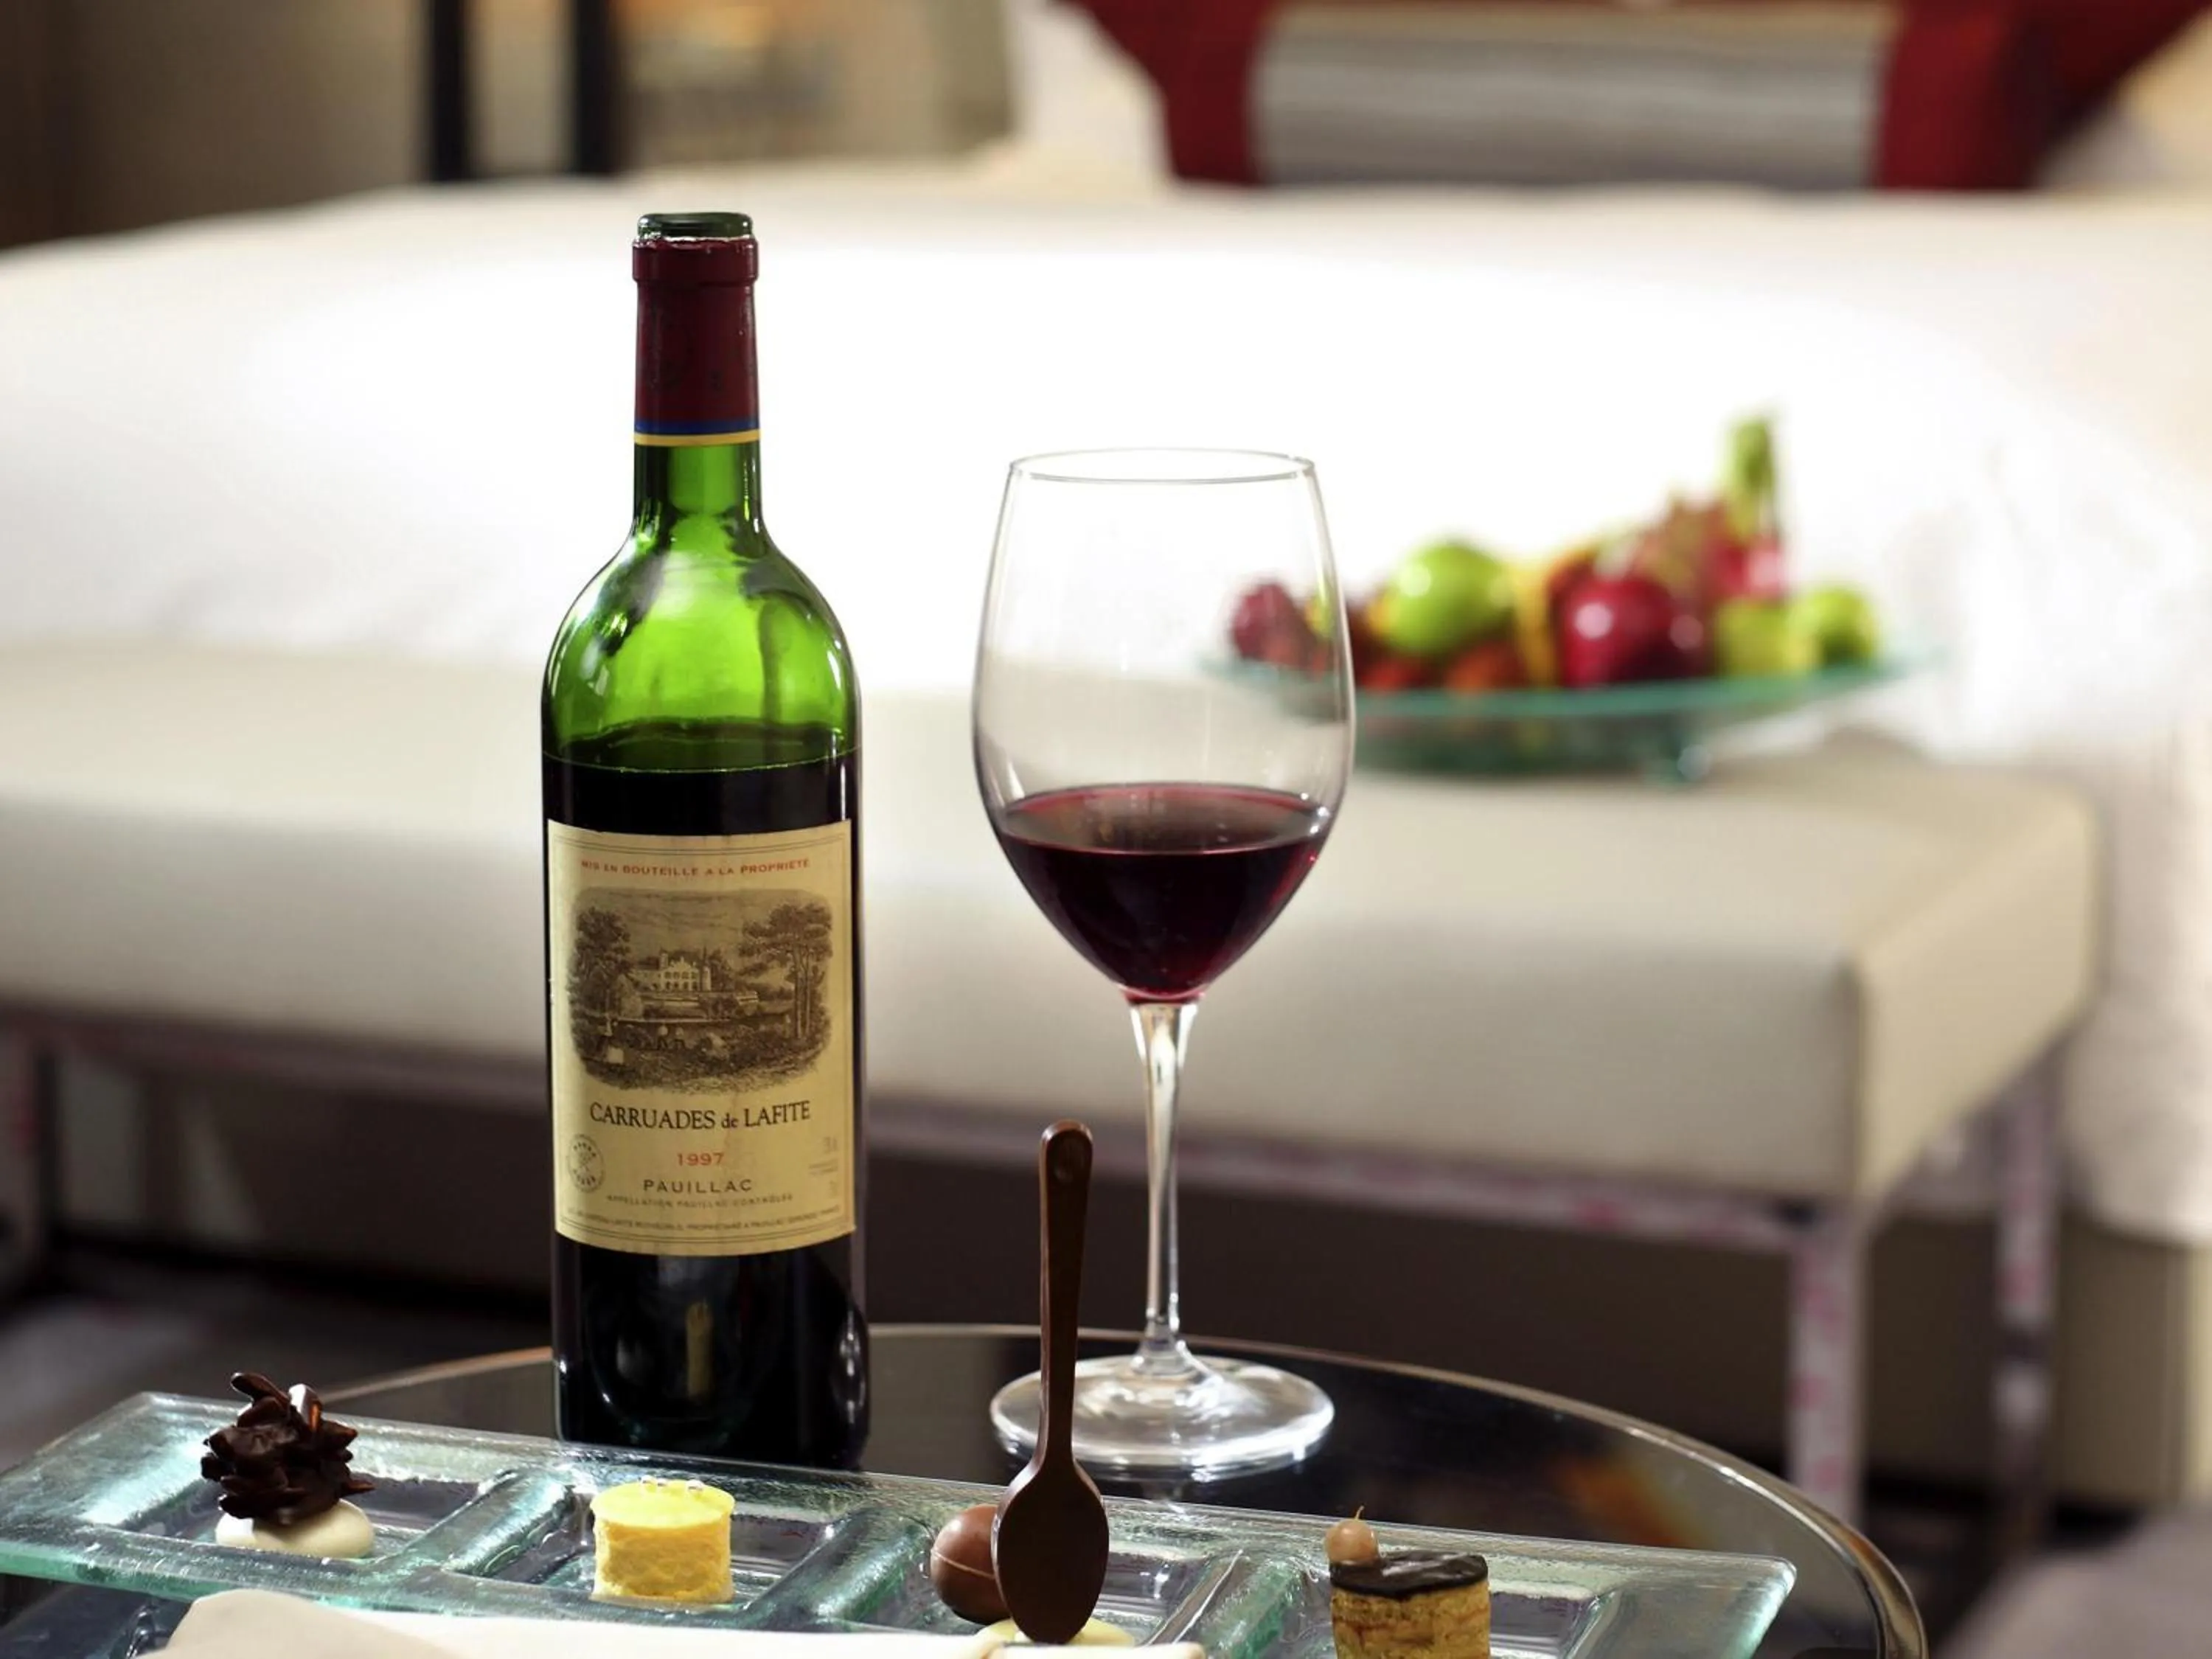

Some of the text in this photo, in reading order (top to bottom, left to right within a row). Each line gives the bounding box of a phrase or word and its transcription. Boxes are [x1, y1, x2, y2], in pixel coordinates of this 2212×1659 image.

[581, 860, 600, 871] MIS
[604, 863, 619, 873] EN
[622, 865, 699, 877] BOUTEILLE
[719, 867, 735, 876] LA
[590, 1100, 811, 1130] CARRUADES de LAFITE
[676, 1152, 726, 1166] 1997
[643, 1179, 753, 1194] PAUILLAC
